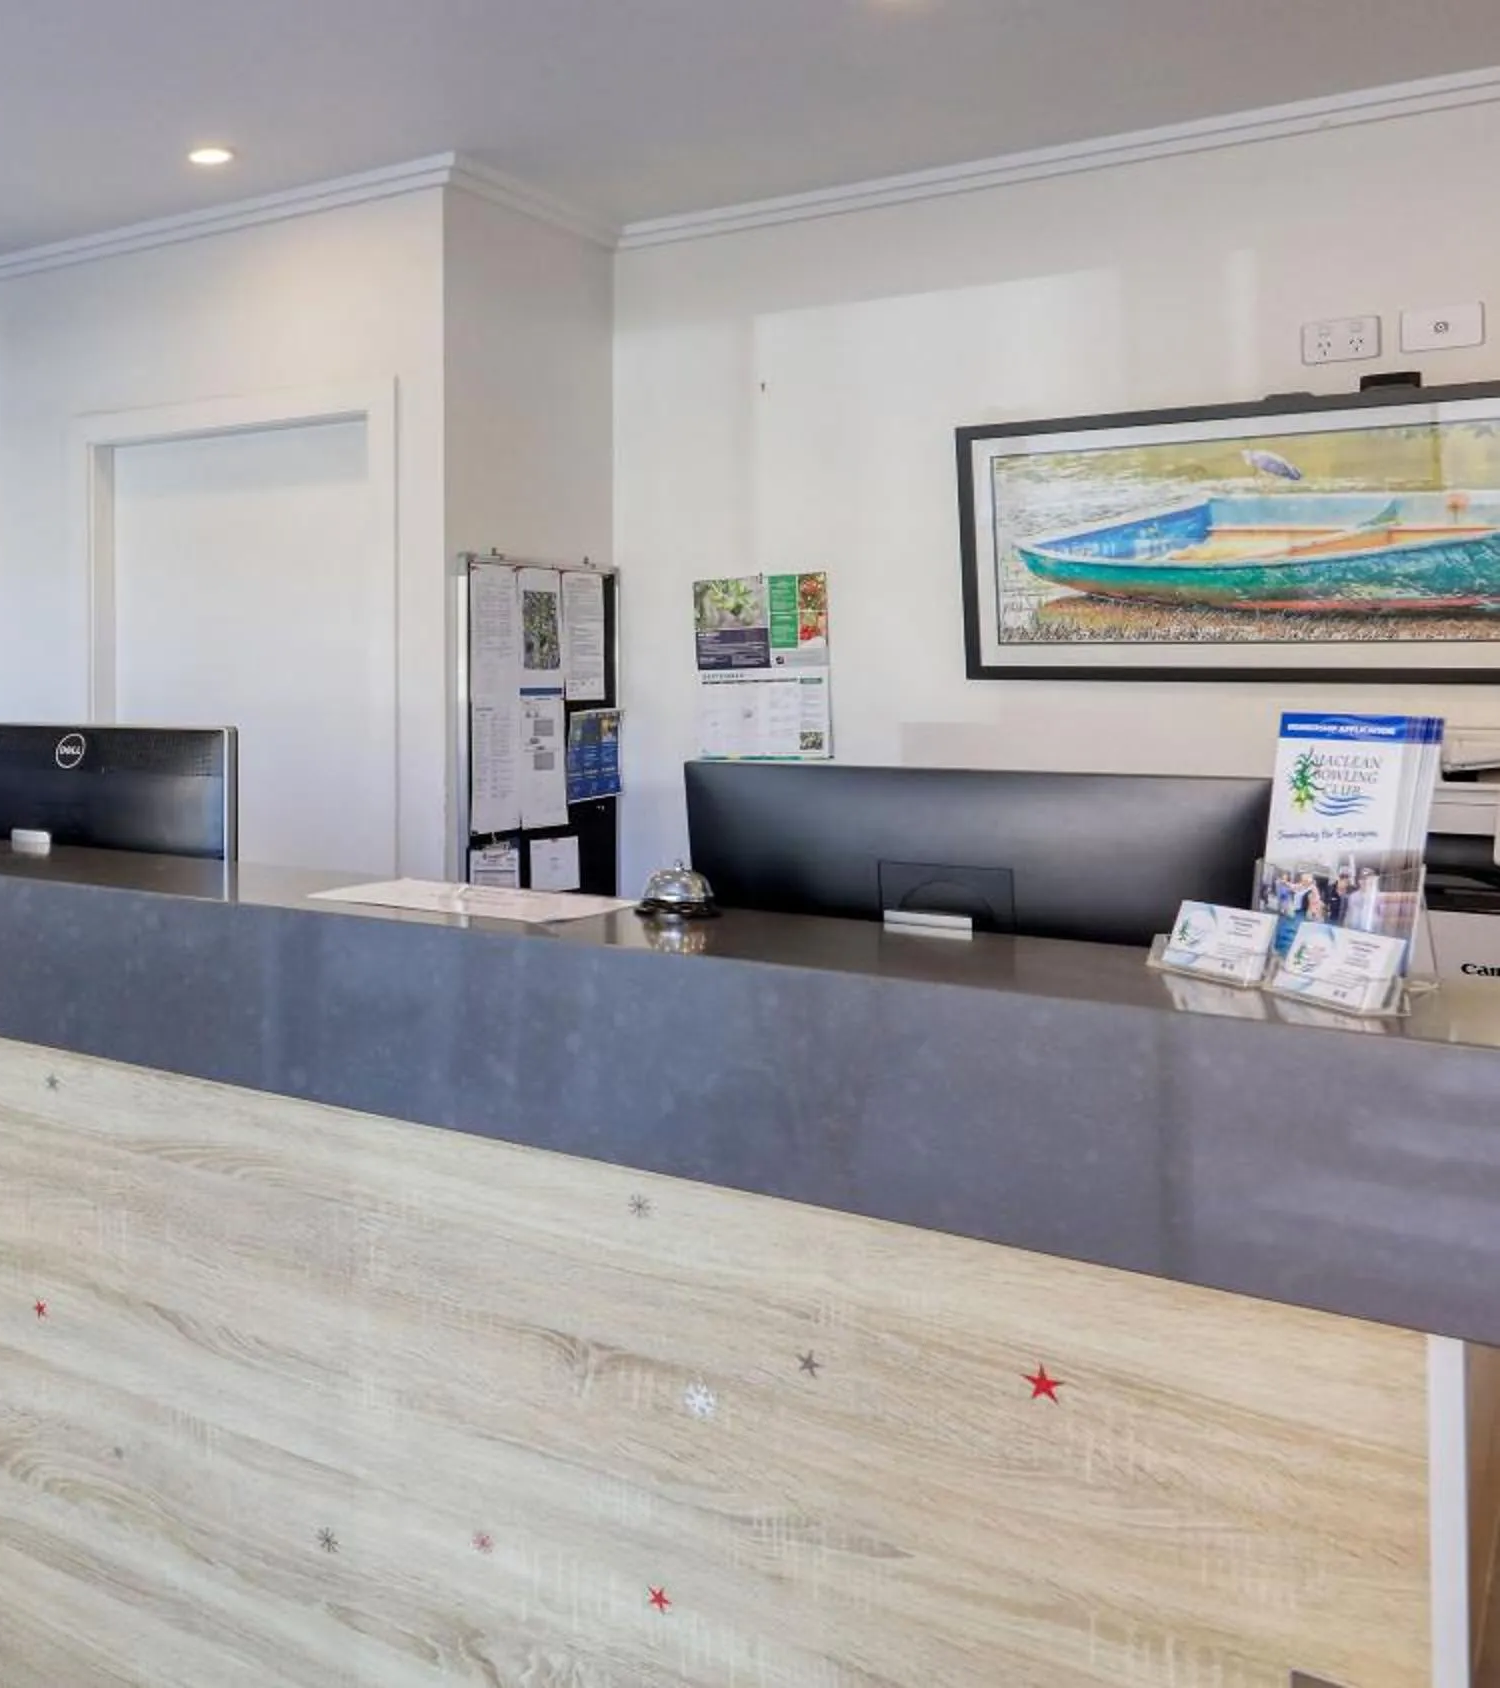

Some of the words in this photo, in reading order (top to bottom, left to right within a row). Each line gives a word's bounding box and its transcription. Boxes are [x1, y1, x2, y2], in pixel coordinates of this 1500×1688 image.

[59, 745, 81, 755] DELL
[1313, 754, 1383, 769] MACLEAN
[1313, 769, 1379, 784] BOWLING
